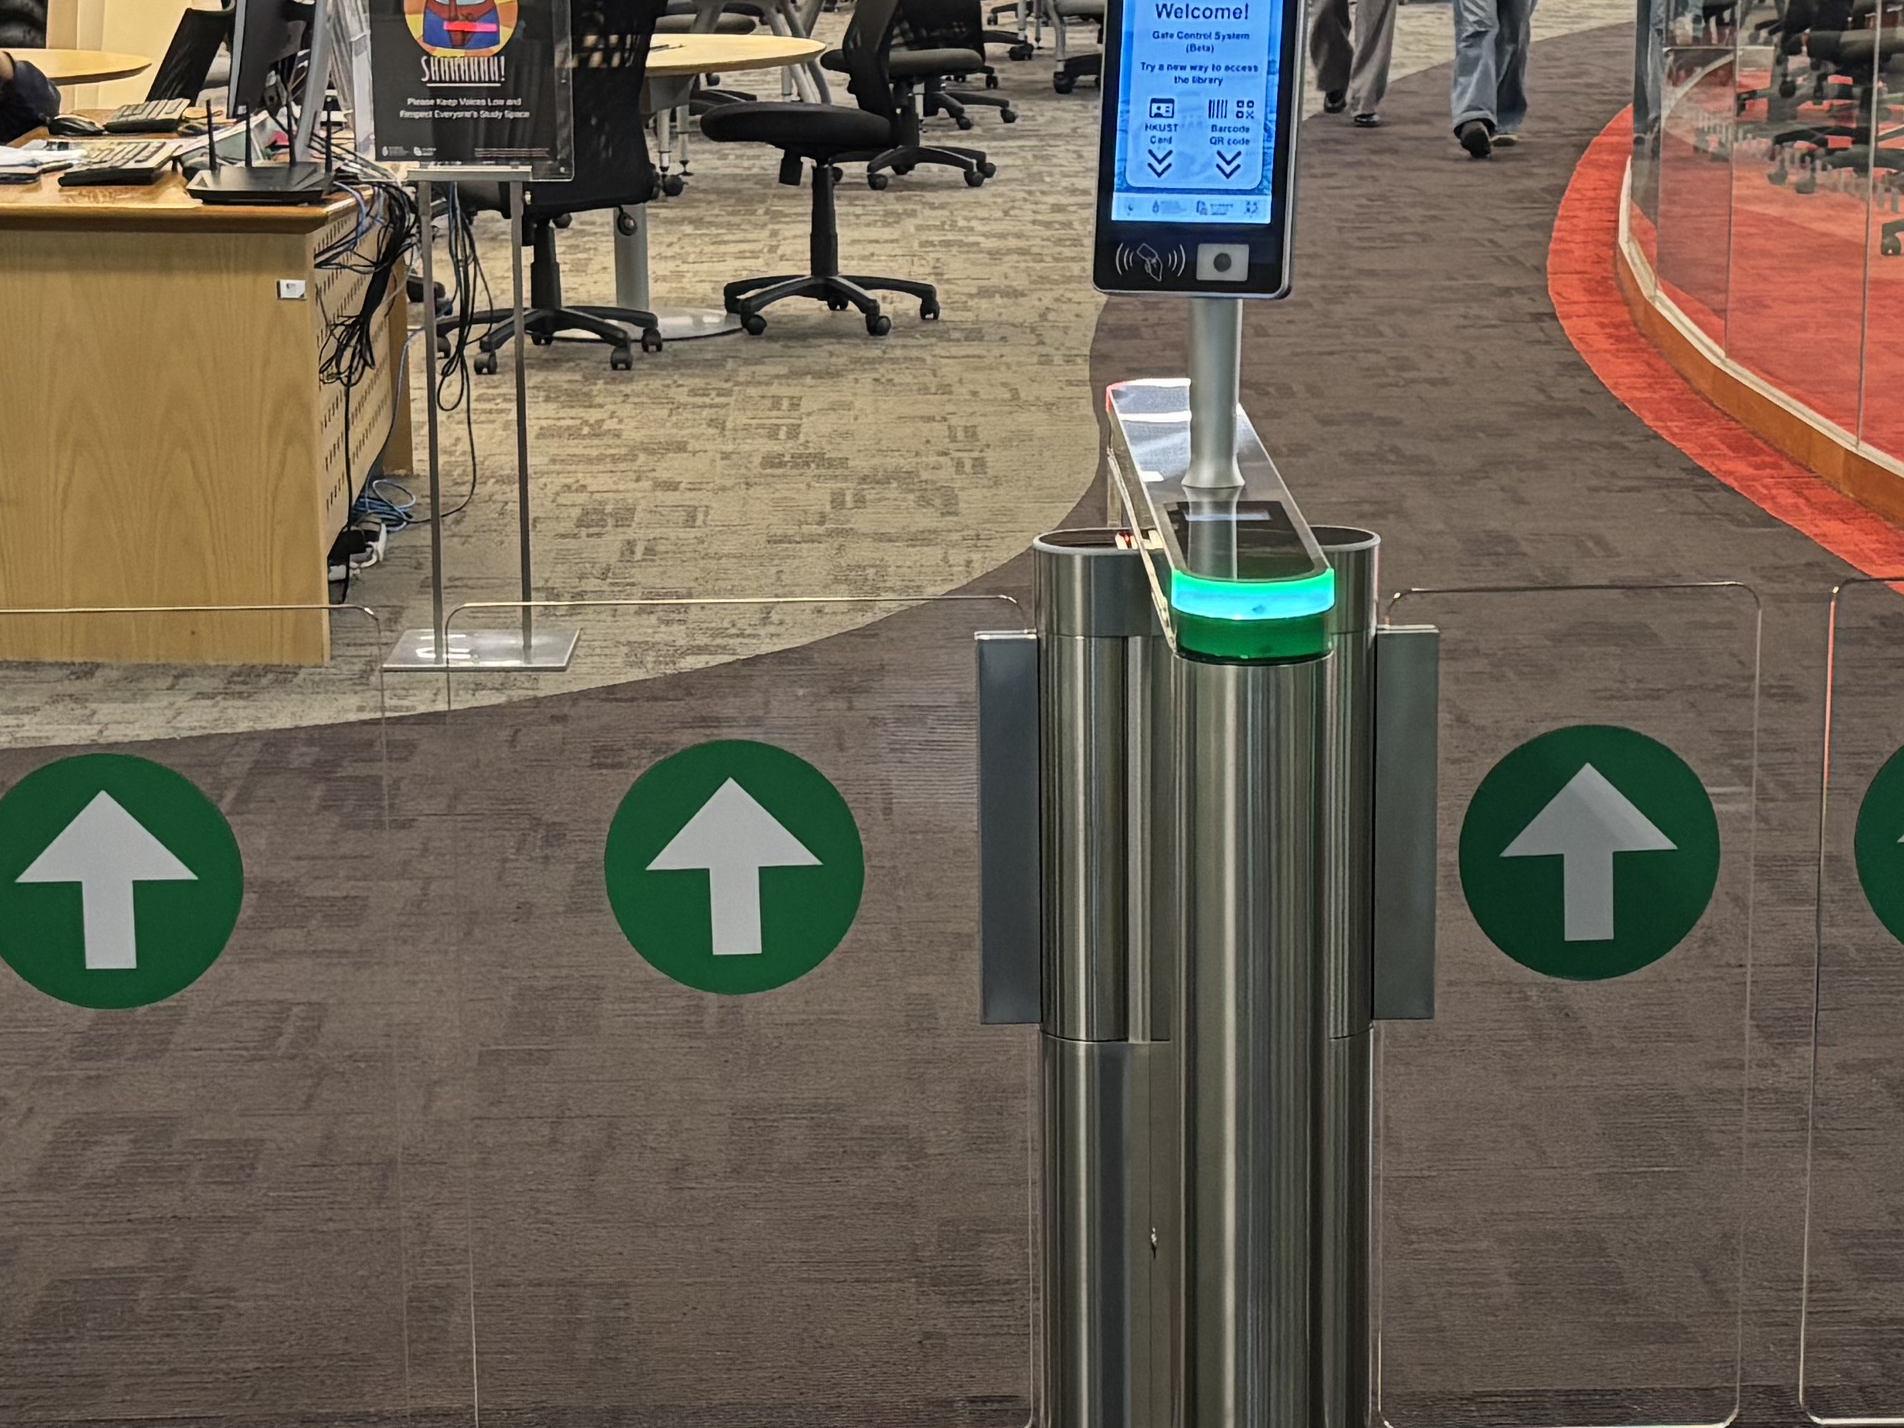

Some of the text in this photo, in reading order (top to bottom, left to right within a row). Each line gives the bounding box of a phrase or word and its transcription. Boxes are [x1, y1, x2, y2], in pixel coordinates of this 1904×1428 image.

[1155, 2, 1249, 20] Welcome!
[1152, 30, 1250, 42] Gate Control System
[1185, 43, 1215, 54] (Beta)
[421, 55, 506, 83] SHHHHHHH!
[1140, 62, 1259, 74] Try a new way to access
[1174, 75, 1224, 87] the library
[1144, 123, 1179, 133] HKUST
[1211, 124, 1250, 134] Barcode
[1150, 135, 1173, 145] Card
[1209, 136, 1250, 146] QR code
